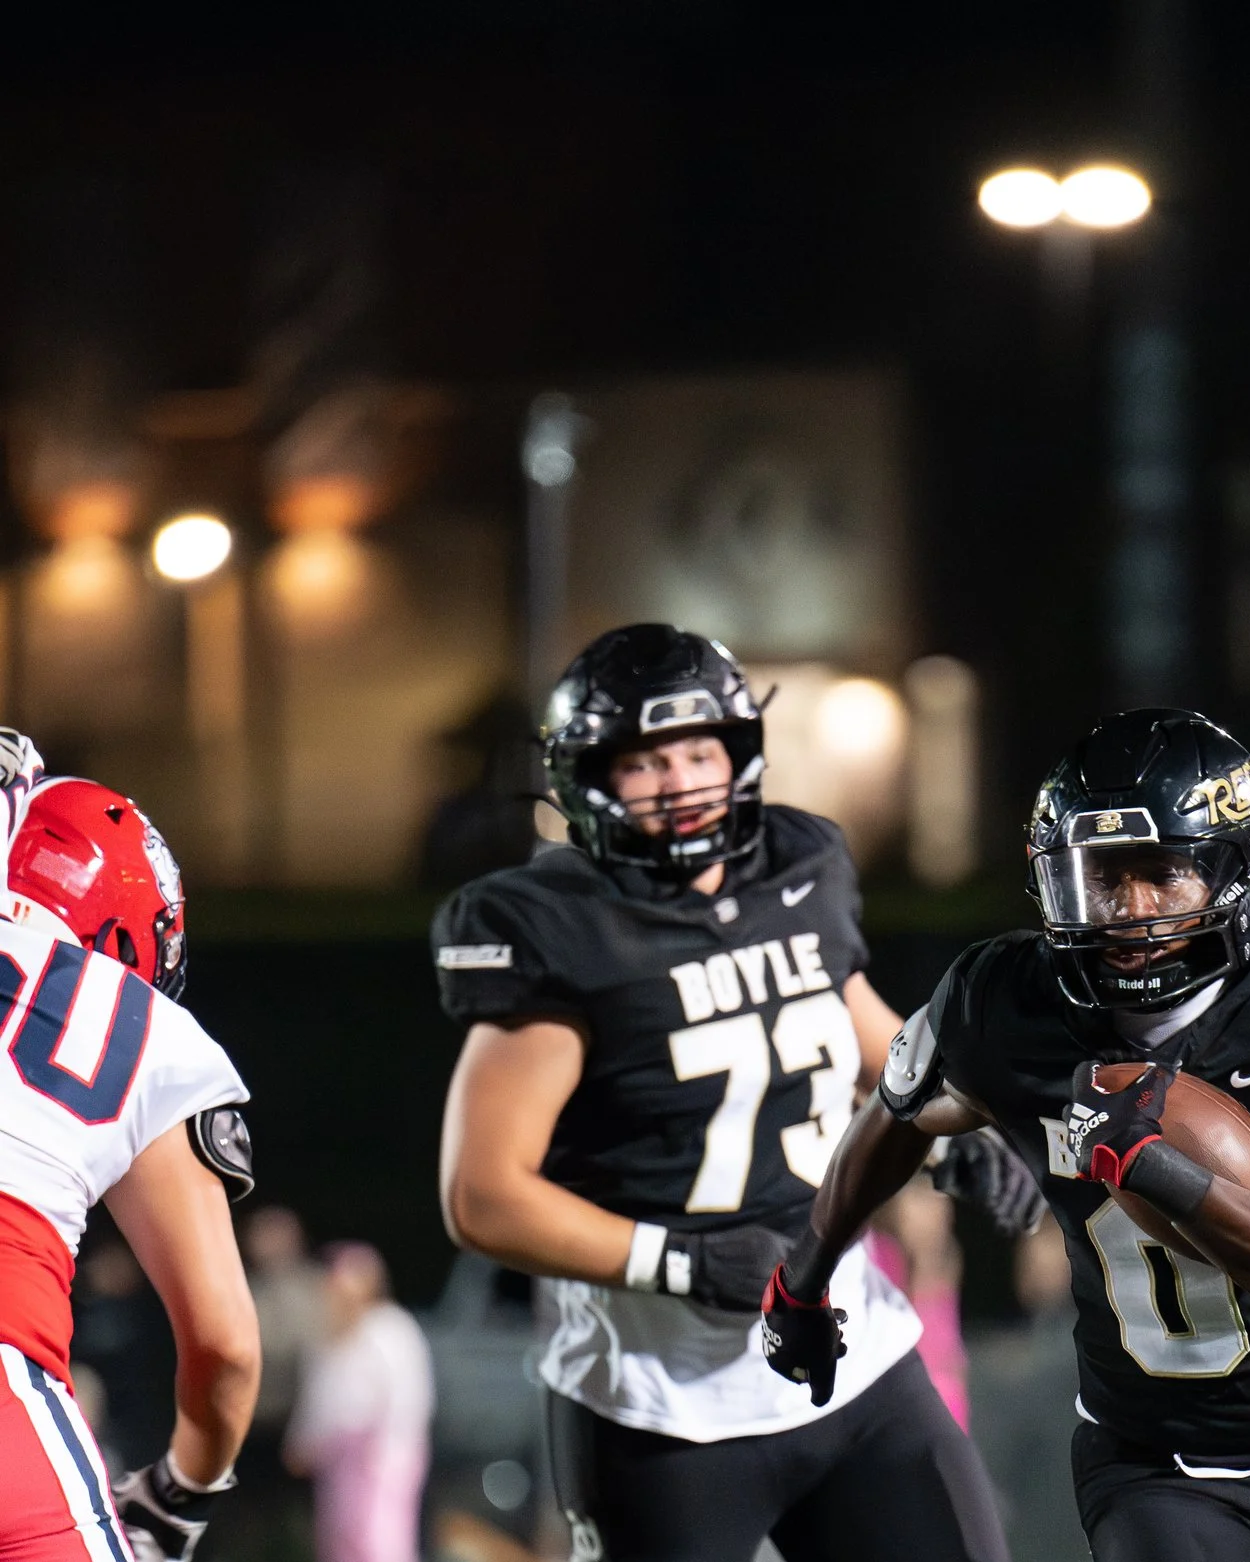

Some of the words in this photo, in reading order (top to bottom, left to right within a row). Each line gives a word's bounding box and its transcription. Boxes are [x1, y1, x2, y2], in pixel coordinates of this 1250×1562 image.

[669, 933, 832, 1024] BOYLE
[1117, 977, 1161, 990] Riddell
[0, 938, 155, 1127] 0
[668, 989, 862, 1214] 73
[1074, 1111, 1110, 1158] adidas
